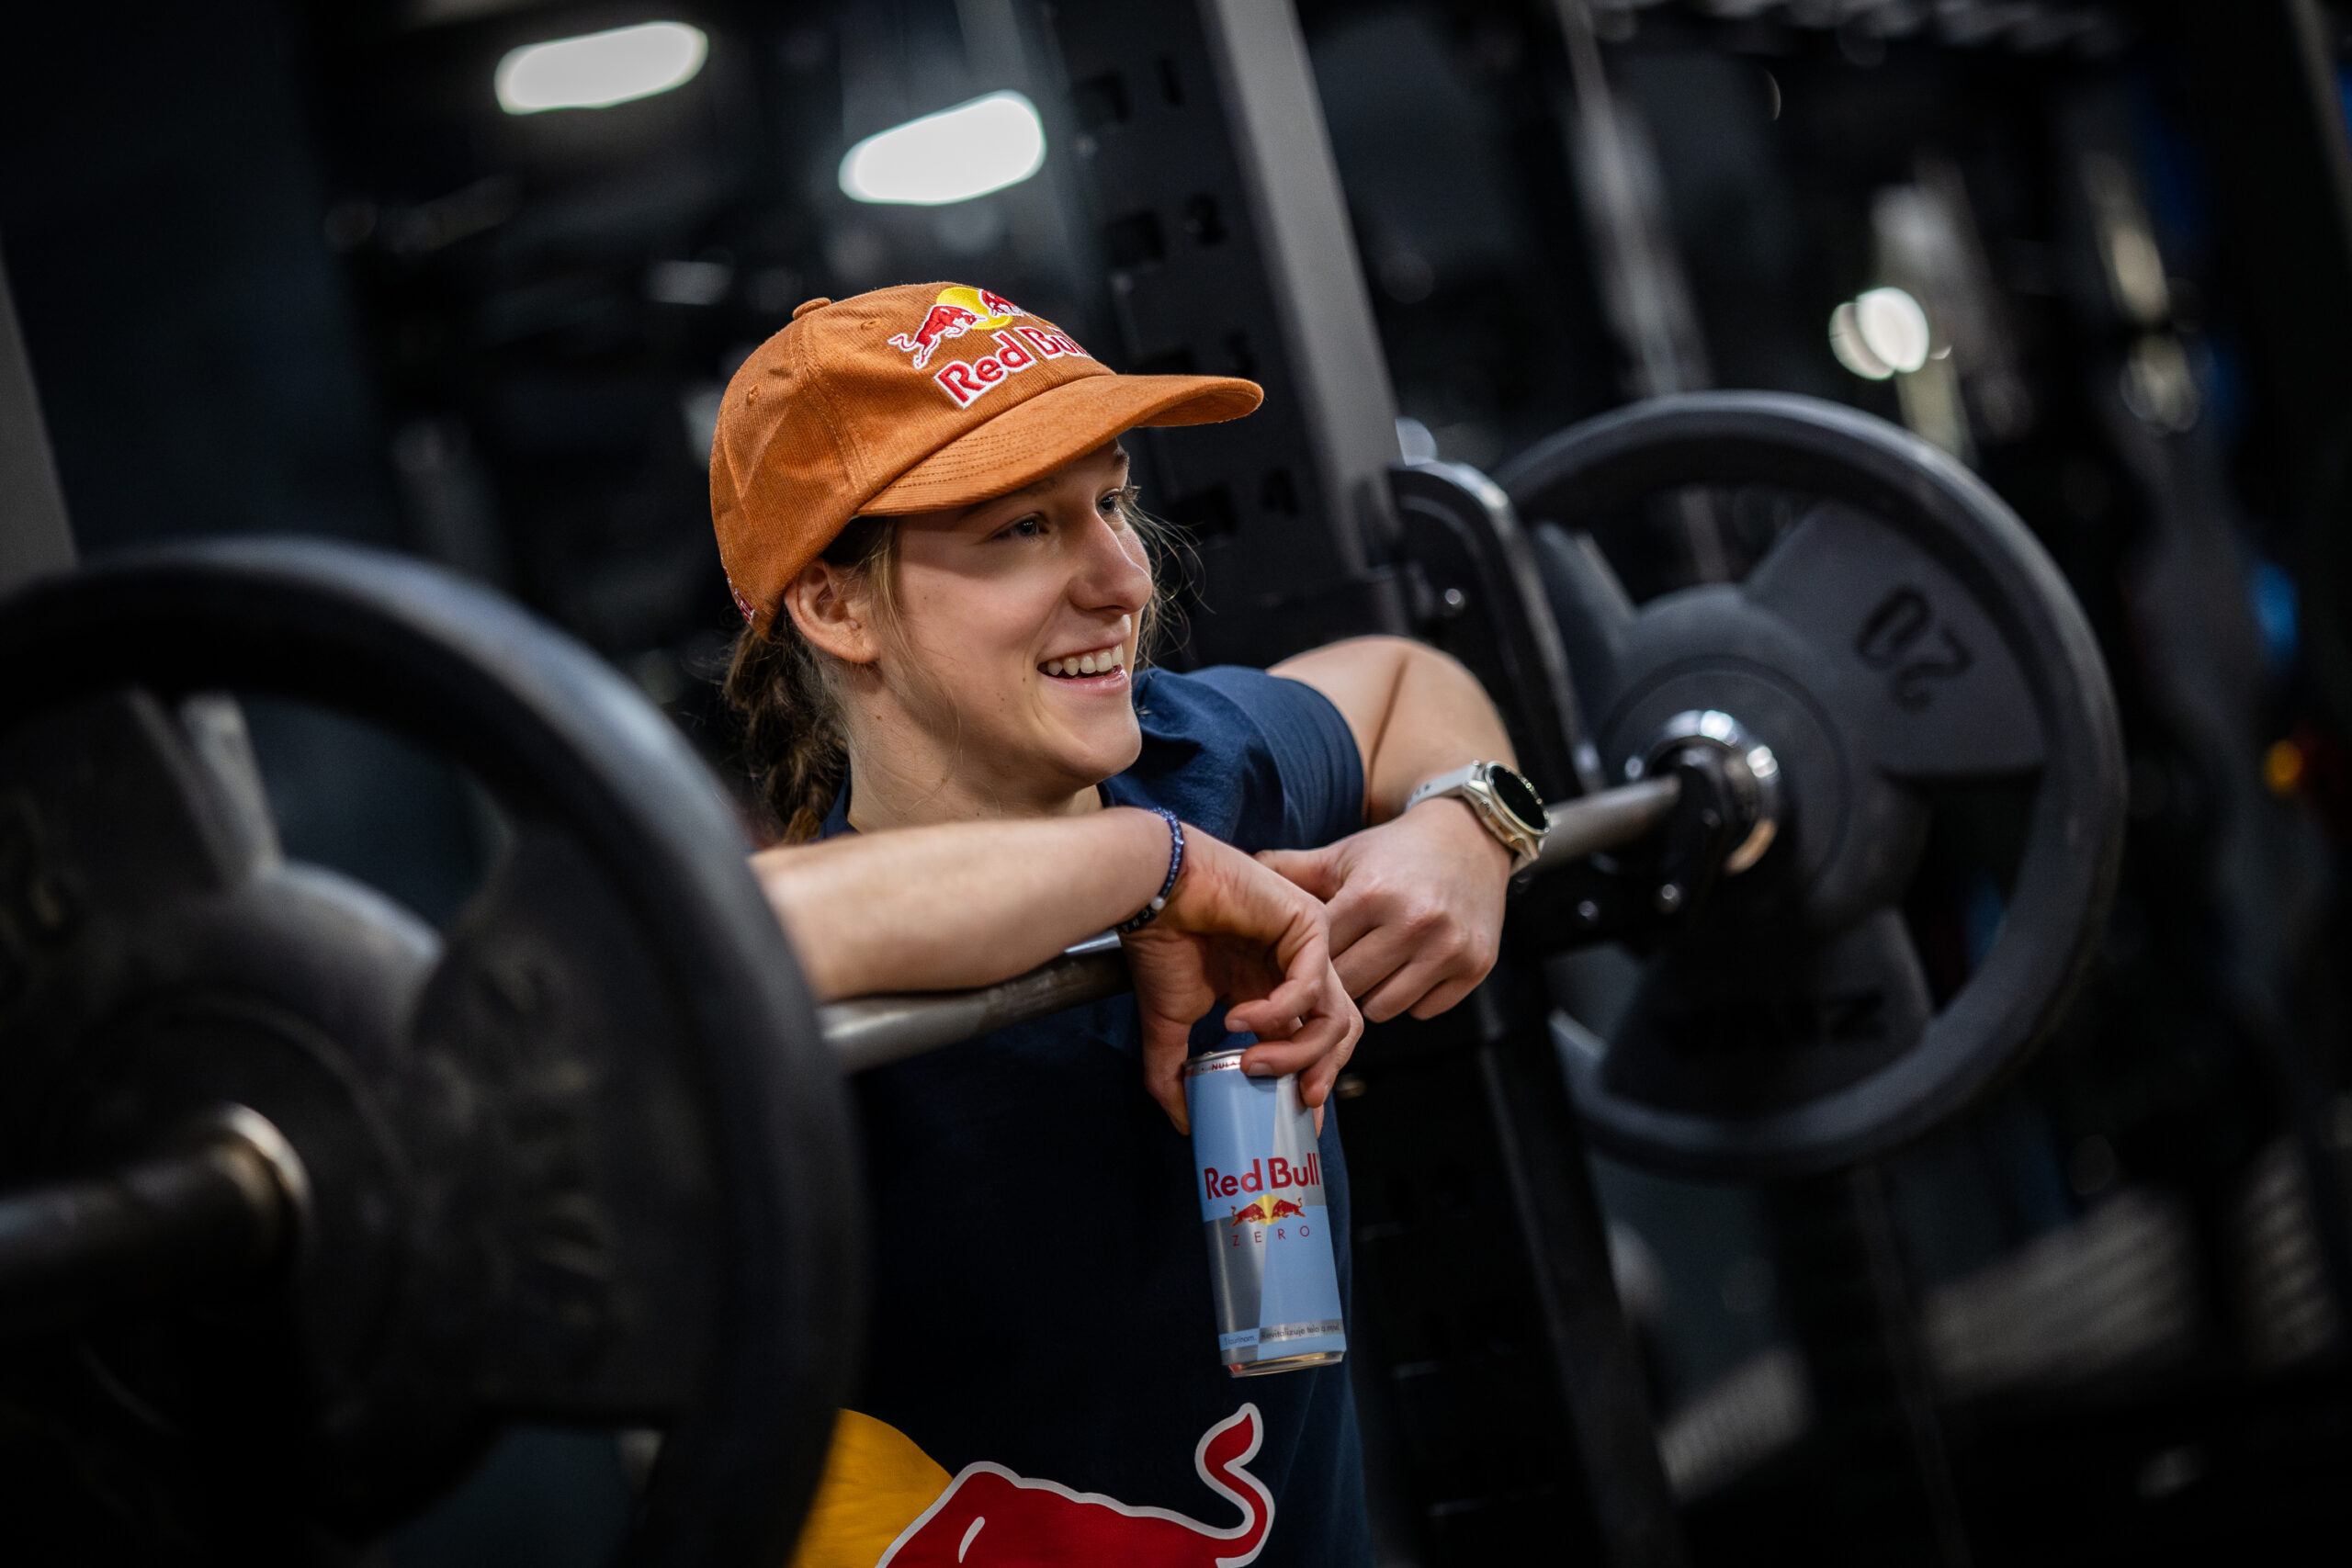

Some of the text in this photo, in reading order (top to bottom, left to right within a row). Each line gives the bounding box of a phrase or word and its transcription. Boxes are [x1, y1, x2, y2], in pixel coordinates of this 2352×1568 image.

[935, 332, 1036, 408] Red
[1854, 584, 1974, 713] 20
[1204, 1152, 1320, 1200] Red Bull
[1231, 1224, 1310, 1247] ZERO
